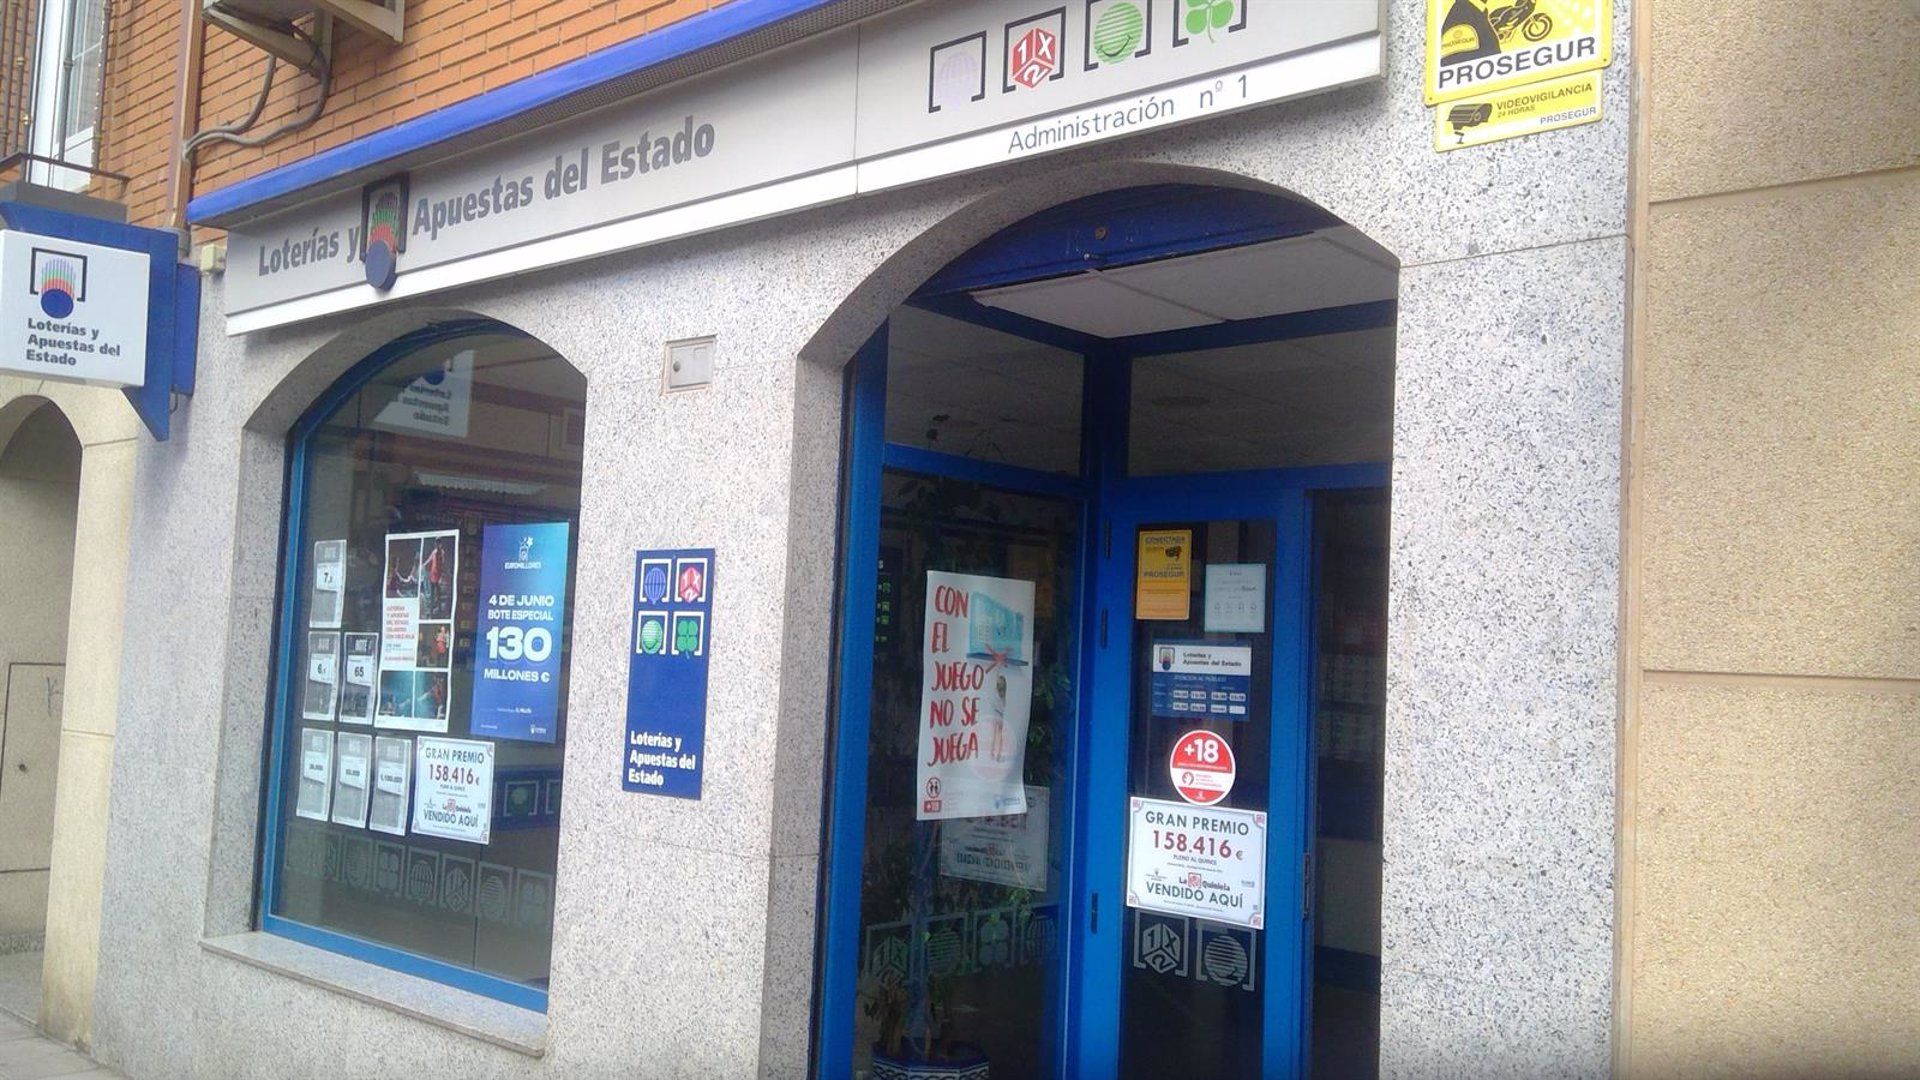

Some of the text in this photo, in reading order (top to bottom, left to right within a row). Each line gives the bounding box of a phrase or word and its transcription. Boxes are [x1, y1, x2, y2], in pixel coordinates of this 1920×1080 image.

[1438, 36, 1596, 89] PROSEGUR
[1496, 83, 1593, 110] VIDEOVIGILANCIA
[1008, 95, 1175, 153] Administración
[1238, 74, 1248, 99] 1
[1540, 106, 1597, 125] PROSEGUR
[258, 115, 716, 277] Loterías y Apuestas del Estado
[28, 317, 99, 340] Loterías y
[26, 348, 77, 366] Estado
[27, 333, 121, 356] Apuestas del
[489, 594, 555, 607] 4 DE JUNIO
[934, 584, 969, 618] CON
[488, 609, 554, 621] BOTE ESPECIAL
[486, 626, 553, 662] 130
[931, 622, 951, 653] EL
[484, 668, 539, 683] MILLONES
[930, 660, 984, 692] JUEGO
[930, 695, 981, 729] NO SE
[630, 730, 682, 753] Loterías y
[927, 732, 979, 767] JUEGA
[1184, 738, 1219, 764] +18
[425, 747, 485, 764] GRAN PREMIO
[629, 749, 696, 770] Apuestas del
[429, 763, 474, 785] 158.416
[628, 767, 664, 786] Estado
[423, 808, 479, 828] VENDIDO AQUÍ
[1145, 811, 1249, 836] GRAN PREMIO
[1153, 830, 1232, 859] 158.416
[1146, 881, 1205, 901] VENDIDO
[1209, 892, 1244, 908] AQUÍ
